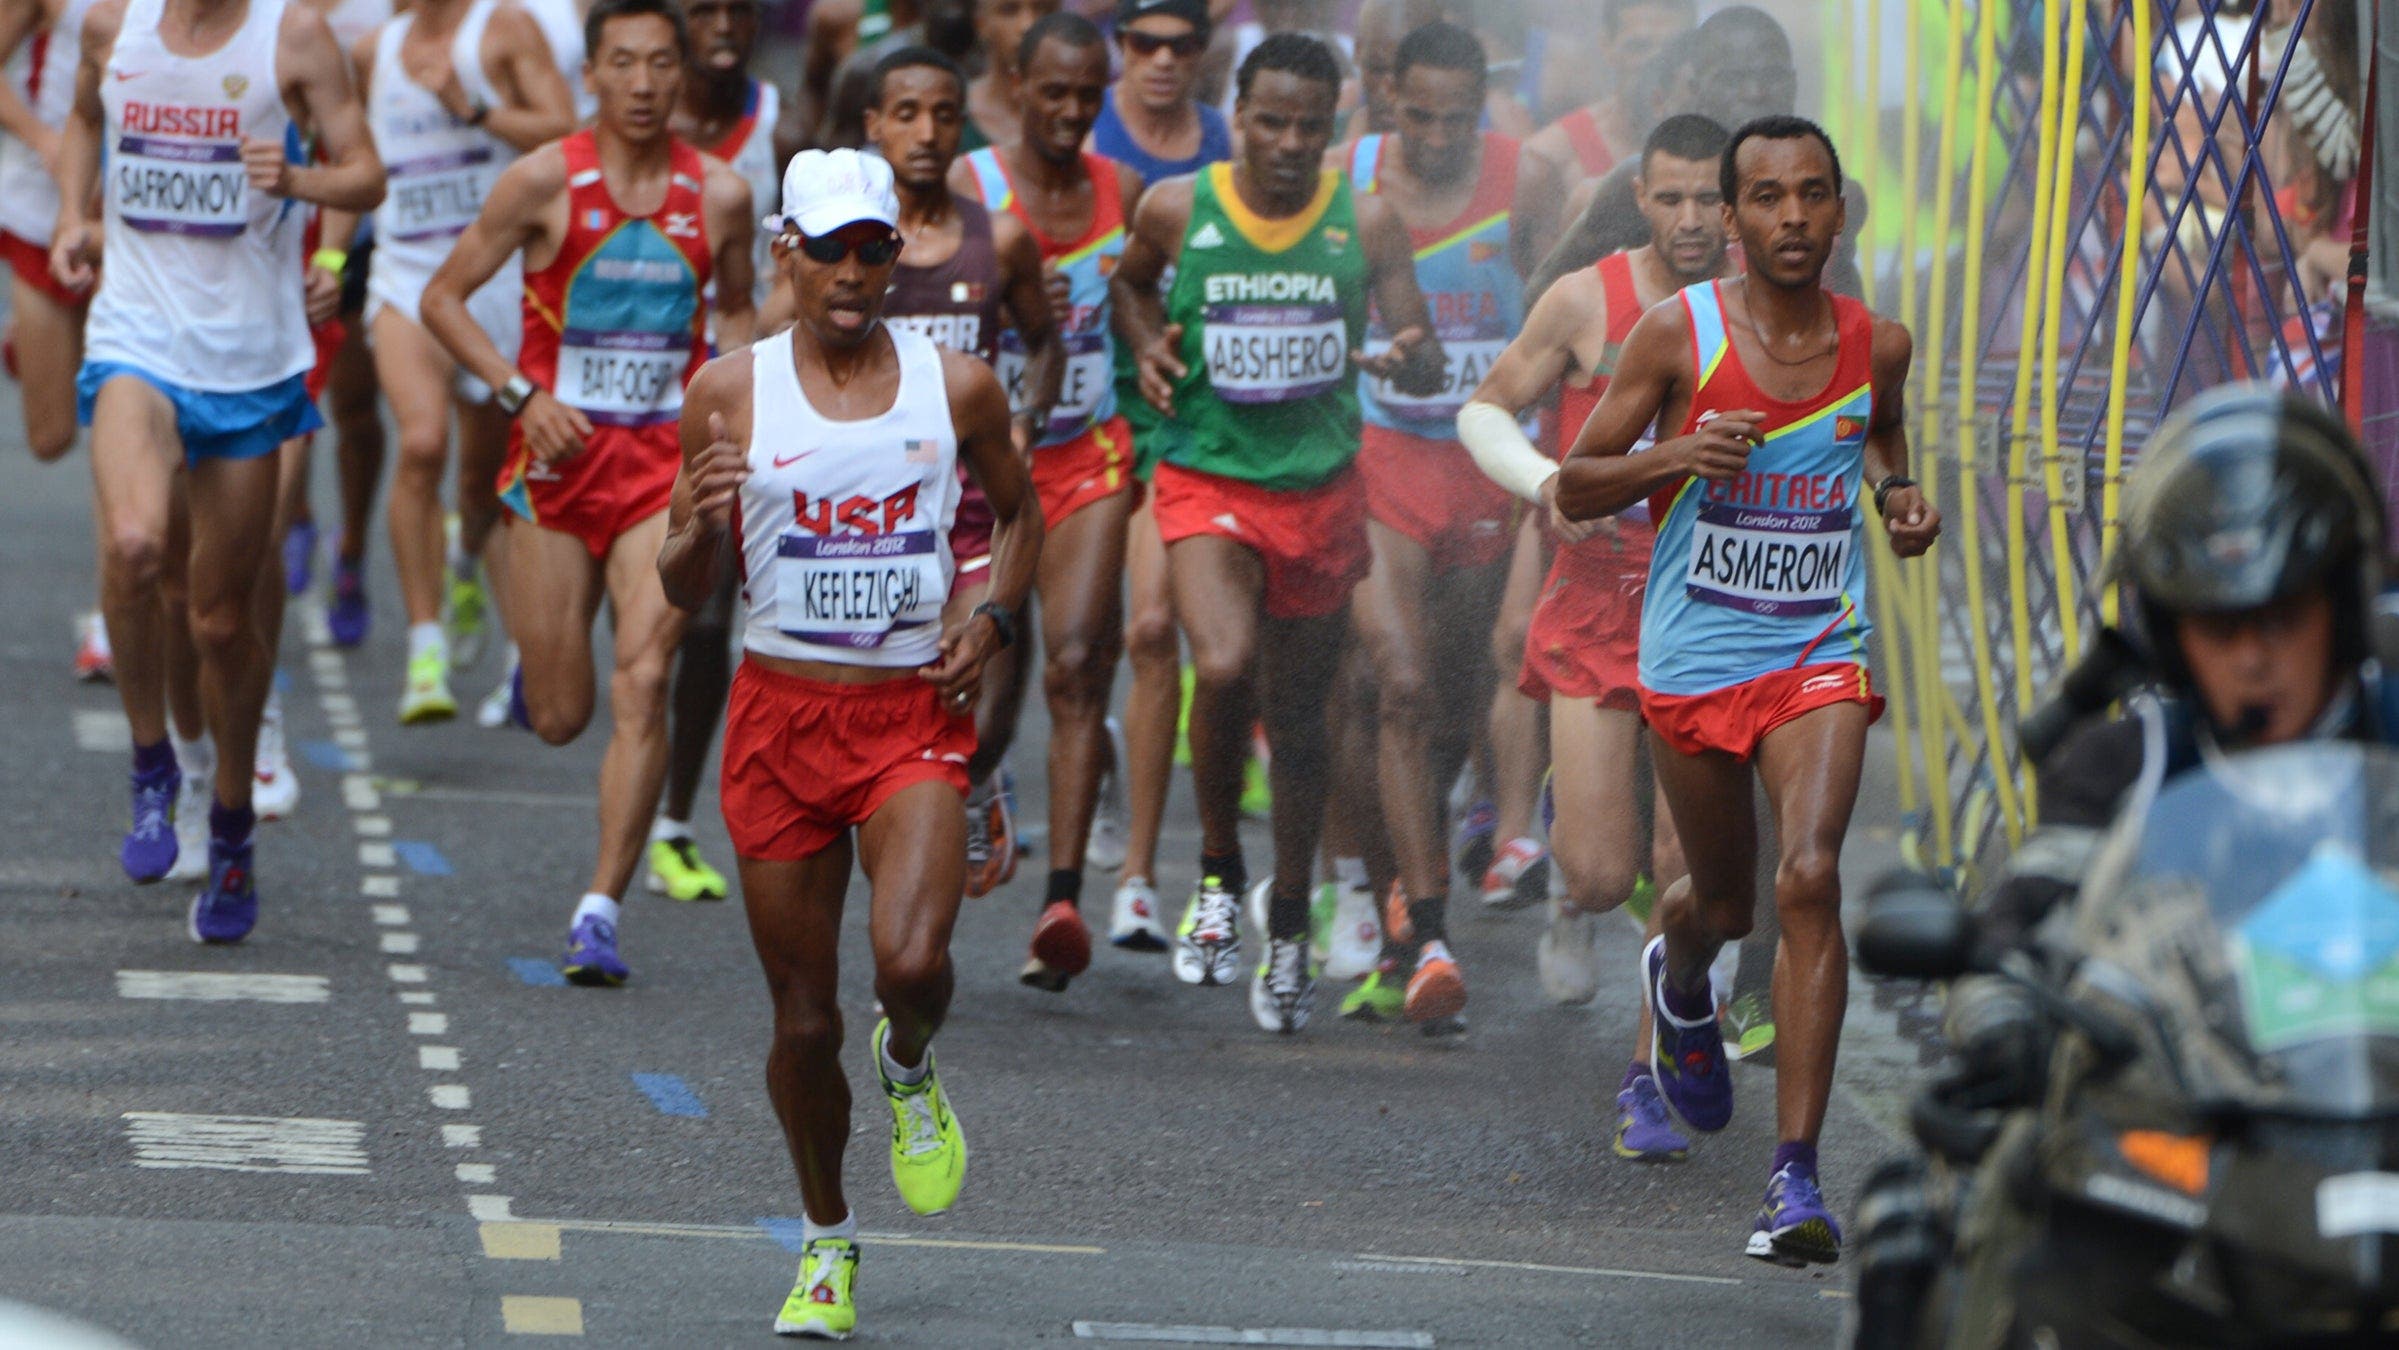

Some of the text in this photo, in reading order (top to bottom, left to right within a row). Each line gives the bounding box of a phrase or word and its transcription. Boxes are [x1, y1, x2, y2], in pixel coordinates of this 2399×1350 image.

[123, 102, 240, 137] RUSSIA
[120, 166, 245, 213] SAFRONOV
[1205, 272, 1338, 304] ETHIOPIA
[1213, 332, 1340, 380] ABSHERO
[793, 479, 922, 538] USA
[1707, 471, 1847, 511] ERITREA
[1734, 511, 1823, 530] London 2012
[815, 536, 906, 557] London 2012
[1693, 532, 1843, 593] ASMEROM
[804, 566, 921, 620] KEFLEZIGHI
